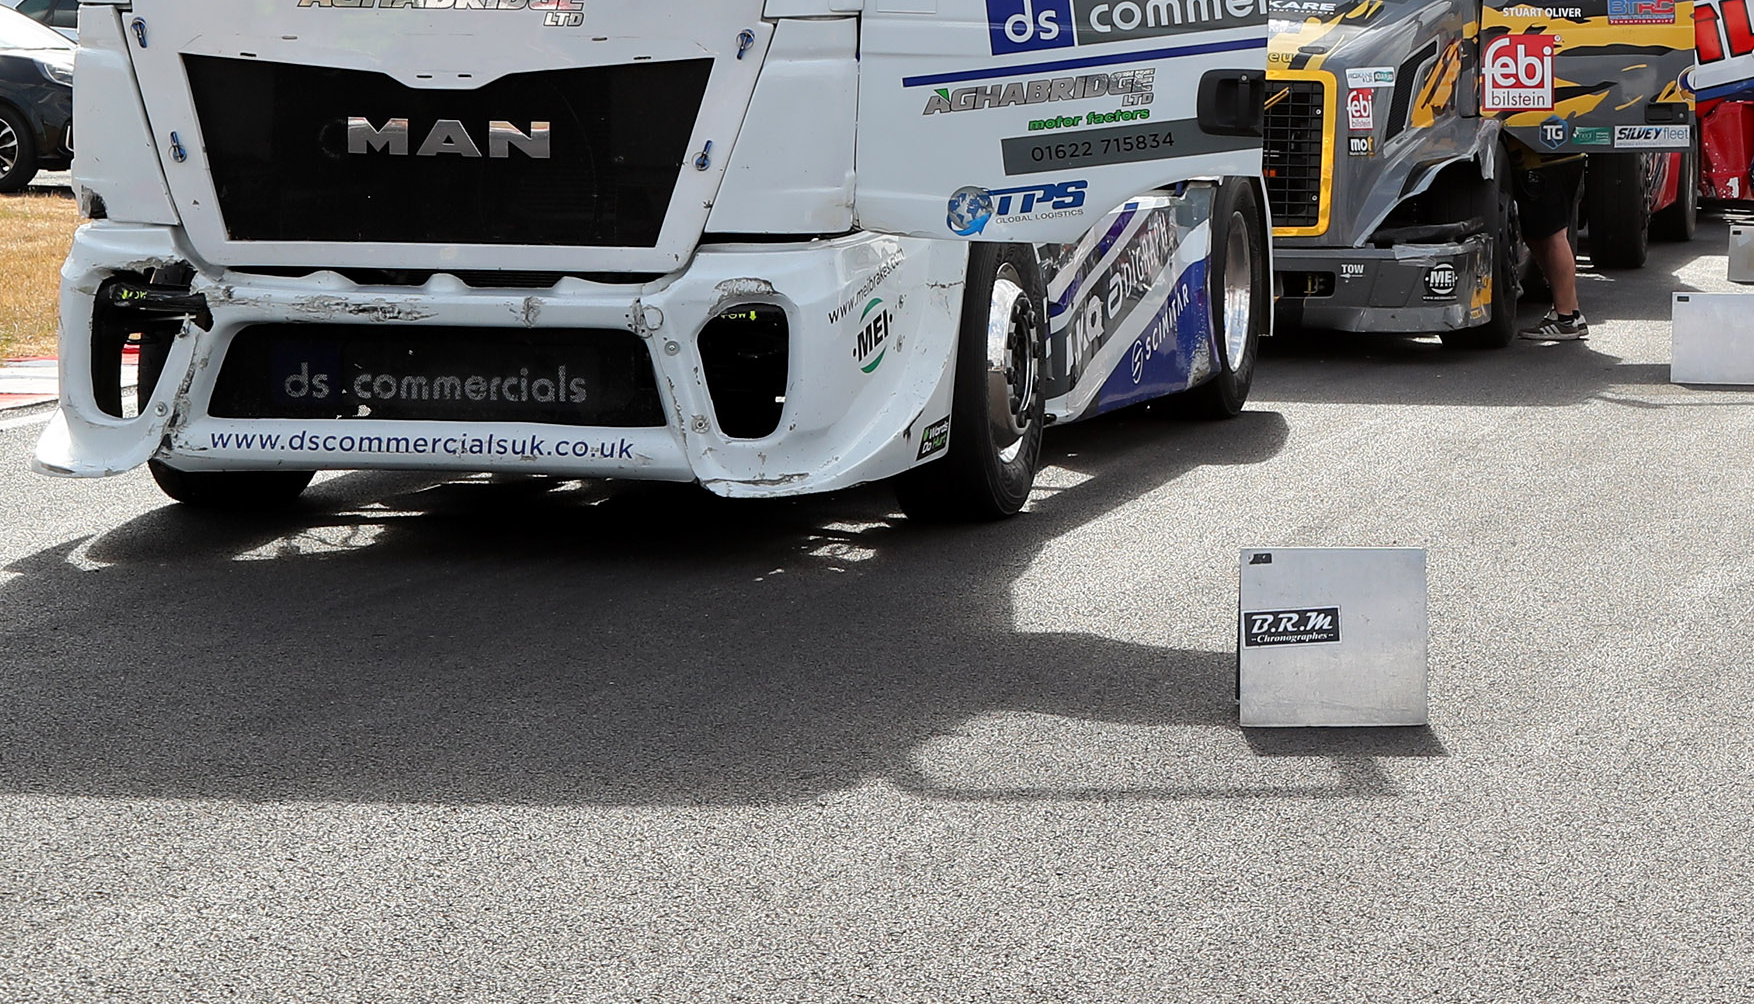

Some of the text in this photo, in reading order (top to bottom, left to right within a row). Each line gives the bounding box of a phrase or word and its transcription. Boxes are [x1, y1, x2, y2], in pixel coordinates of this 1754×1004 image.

[543, 12, 585, 27] LTD
[1502, 7, 1582, 17] STUART OLIVER
[1482, 37, 1552, 87] febi
[922, 67, 1157, 116] AGHABRIDGE
[1122, 93, 1155, 107] LTD
[1347, 90, 1373, 117] febi
[1492, 91, 1545, 106] bilstein
[1028, 108, 1150, 131] motor factors
[1543, 125, 1563, 140] TG
[347, 117, 551, 159] MAN
[1031, 132, 1175, 162] 01622 715834
[1616, 127, 1662, 140] SILVEY
[1663, 127, 1689, 140] fleet
[993, 180, 1088, 215] TPS
[996, 209, 1084, 224] GLOBAL LOGISTICS
[1341, 264, 1364, 273] TOW
[857, 308, 890, 362] MEI
[1146, 283, 1190, 360] SCIMITAR
[284, 362, 588, 404] ds commercials
[210, 431, 634, 458] www.dscommercialsuk.co.uk
